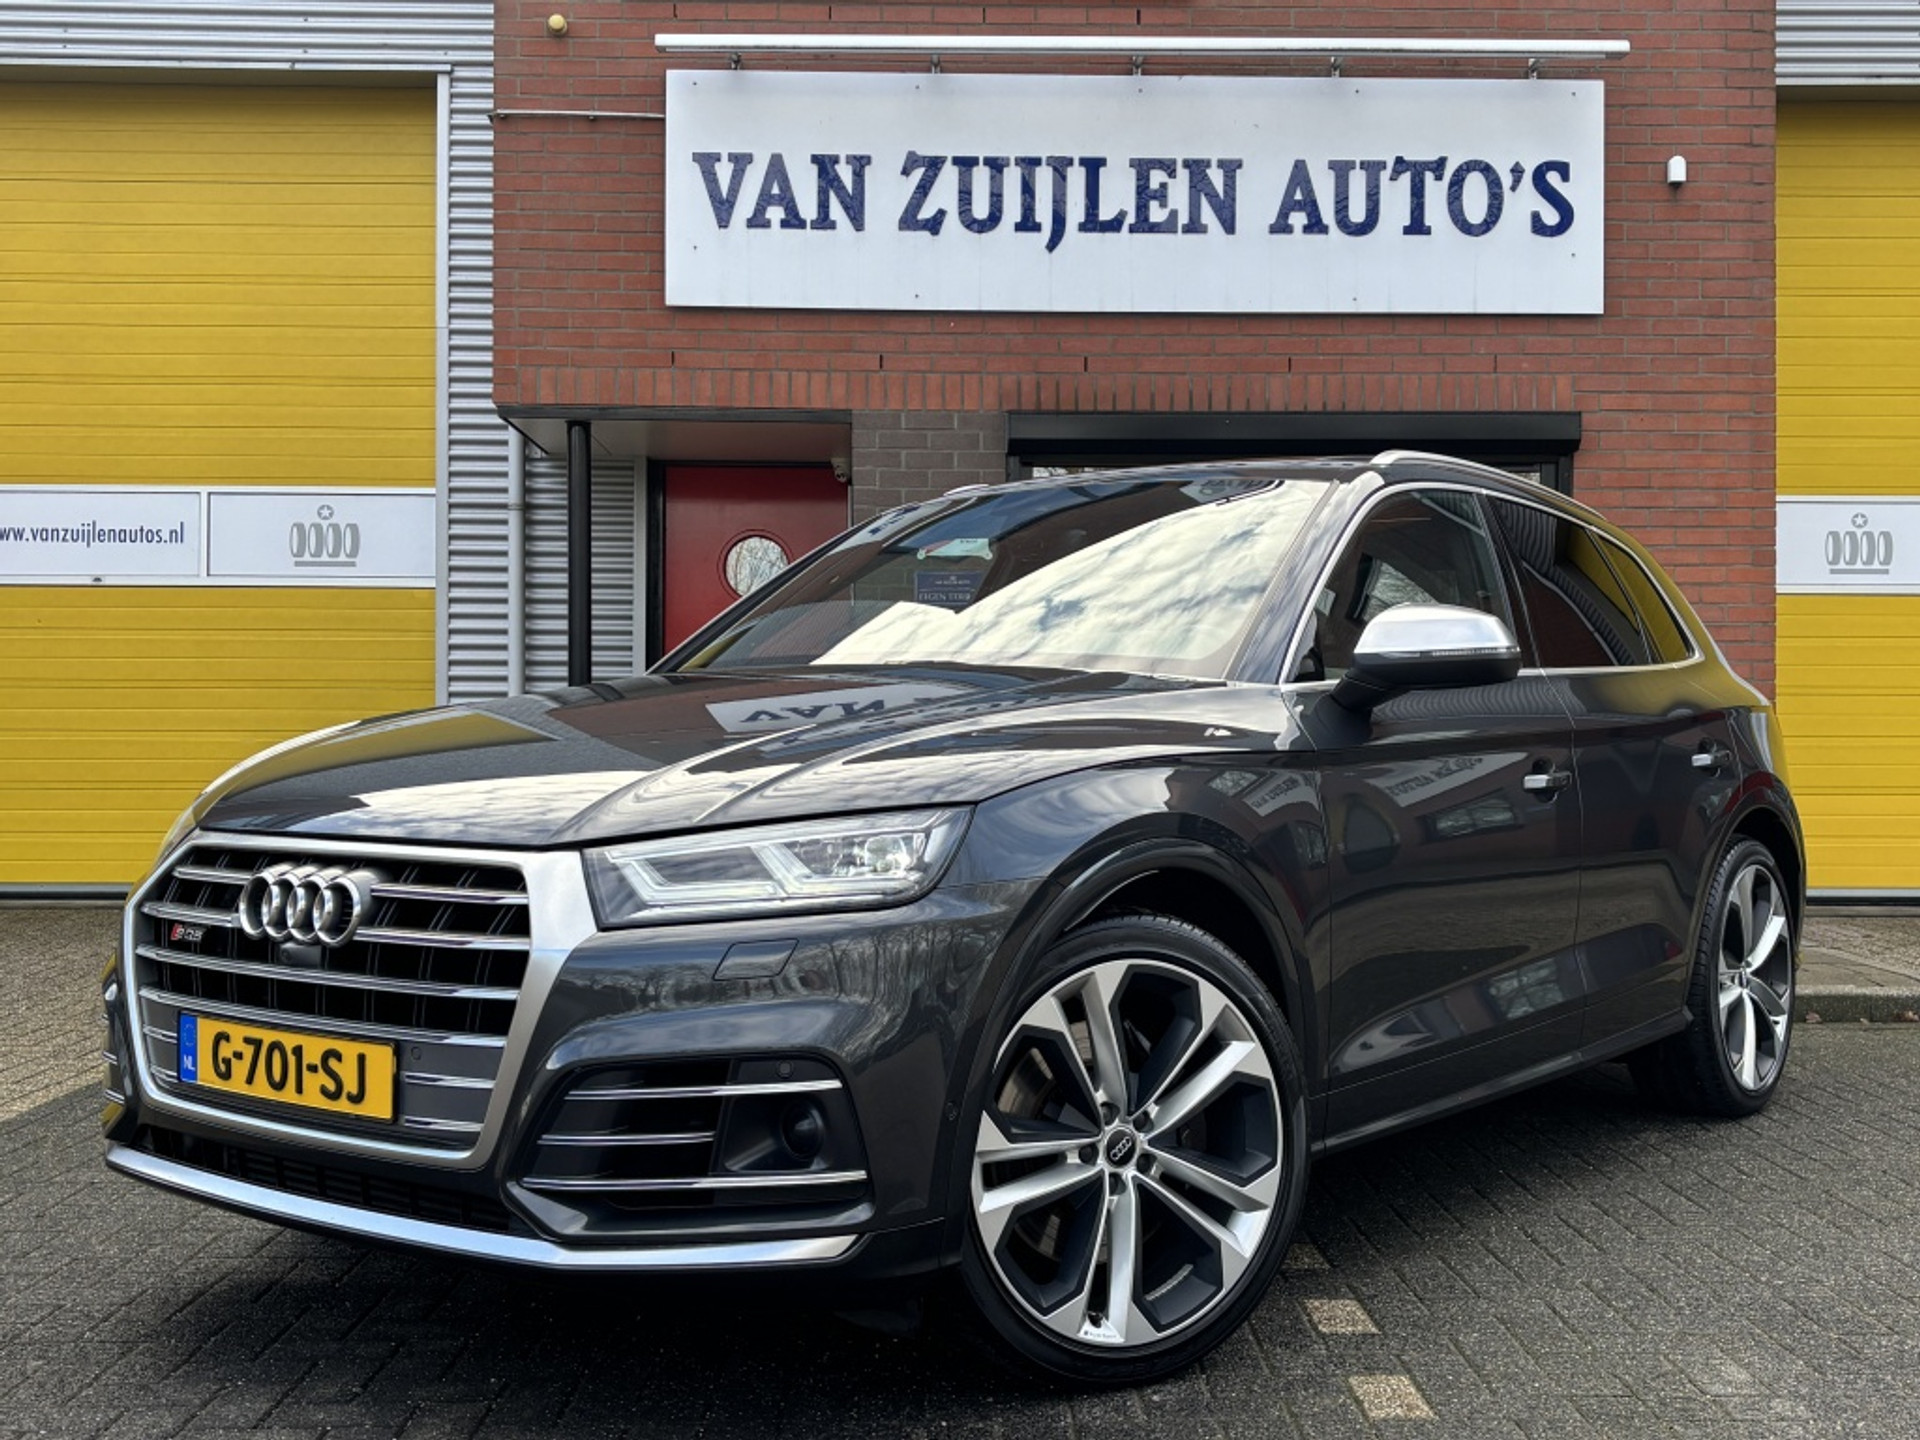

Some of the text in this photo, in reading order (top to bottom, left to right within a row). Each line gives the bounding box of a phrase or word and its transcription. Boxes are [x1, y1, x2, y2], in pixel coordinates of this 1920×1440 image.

[691, 150, 1576, 254] VAN ZUIJLEN AUTO'S
[183, 1055, 196, 1071] NL
[211, 1030, 367, 1105] G-701-SJ
